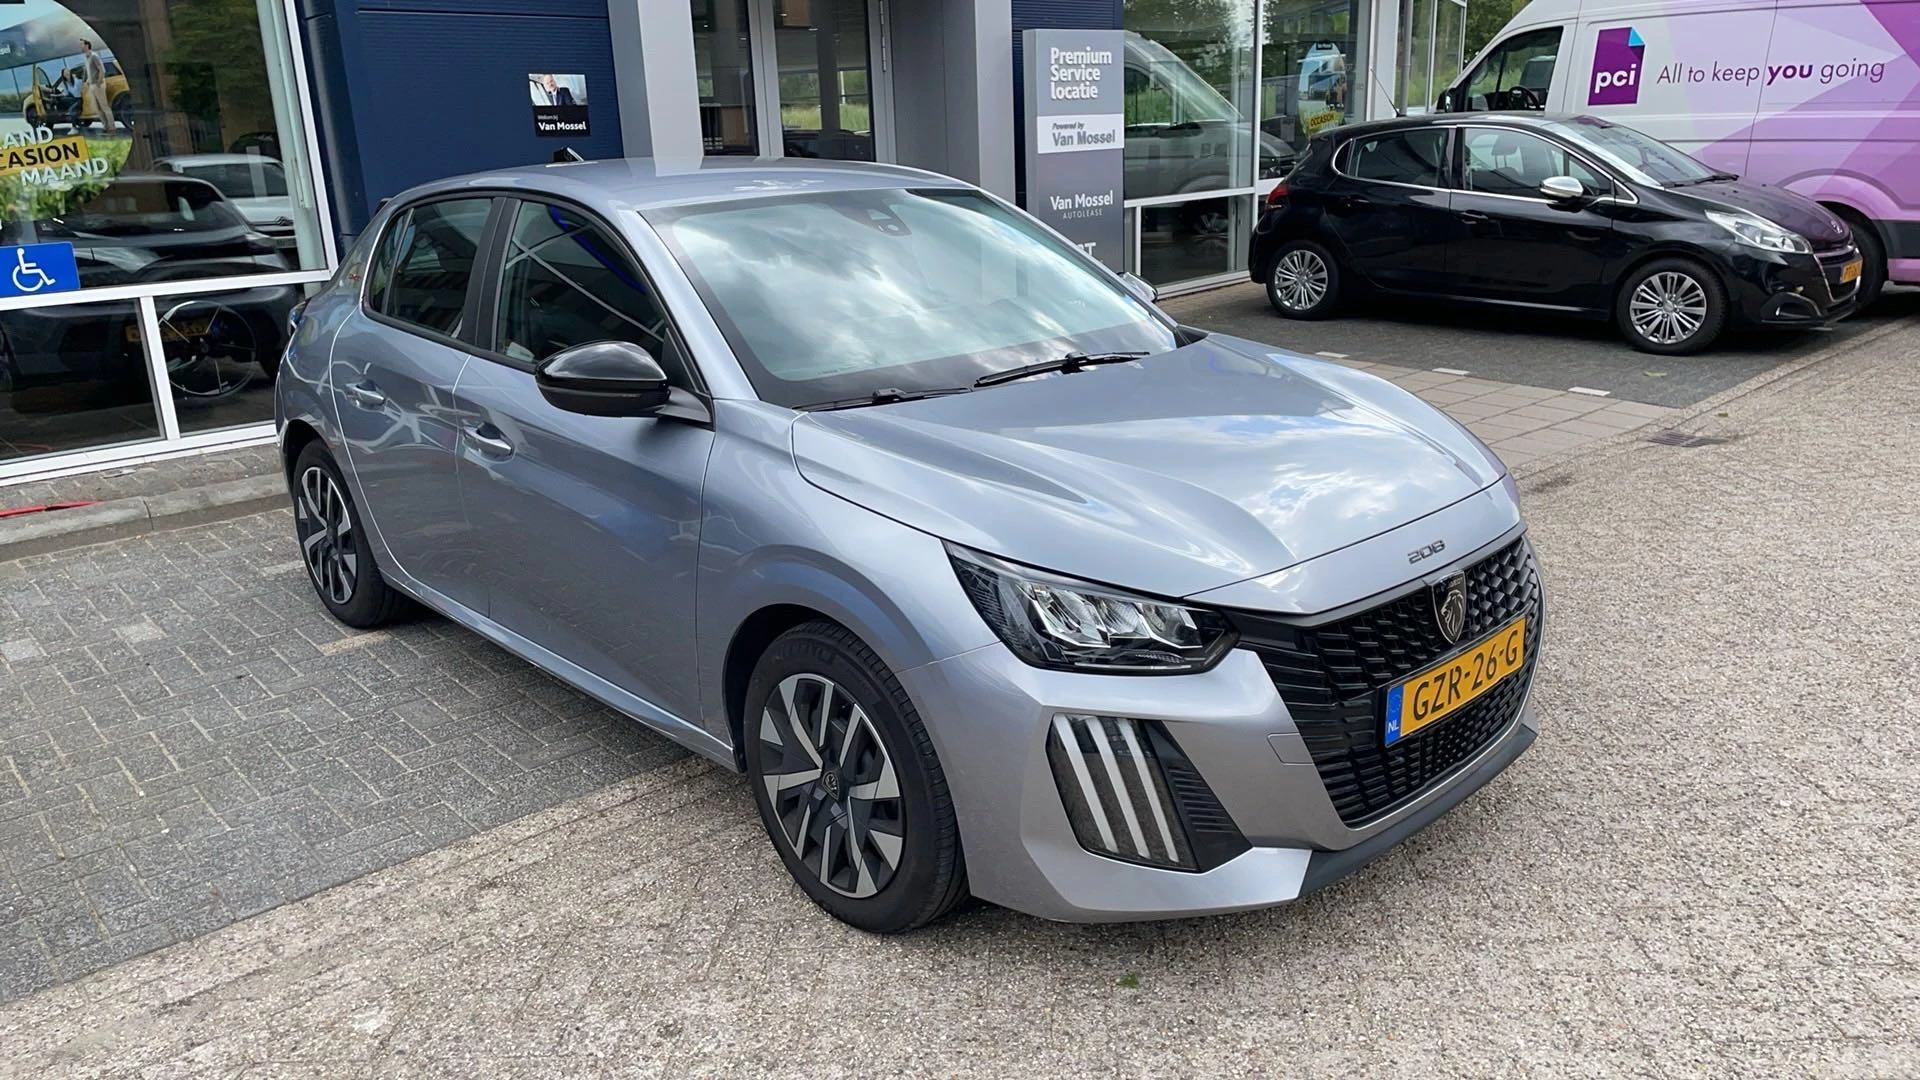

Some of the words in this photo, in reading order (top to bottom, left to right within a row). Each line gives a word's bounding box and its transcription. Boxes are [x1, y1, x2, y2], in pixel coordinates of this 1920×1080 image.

[1050, 46, 1112, 65] Premium
[1050, 64, 1101, 81] Service
[1594, 64, 1637, 93] pci
[1657, 63, 1683, 84] All
[1688, 66, 1705, 82] to
[1712, 61, 1760, 87] keep
[1766, 65, 1813, 86] you
[1820, 58, 1885, 85] going
[1050, 81, 1098, 99] locatie
[538, 122, 555, 130] Van
[557, 121, 586, 130] Mossel
[1052, 122, 1077, 130] Powered
[1077, 122, 1085, 131] by
[0, 126, 54, 150] AND
[1052, 132, 1074, 146] Van
[1077, 129, 1116, 145] Mossel
[21, 157, 108, 187] MAAND
[1050, 196, 1072, 211] Van
[1075, 189, 1113, 208] Mossel
[1062, 208, 1103, 220] AUTOLEASE
[1408, 540, 1446, 565] 208
[1413, 629, 1518, 721] GZR-26-G
[1387, 719, 1400, 734] NL
